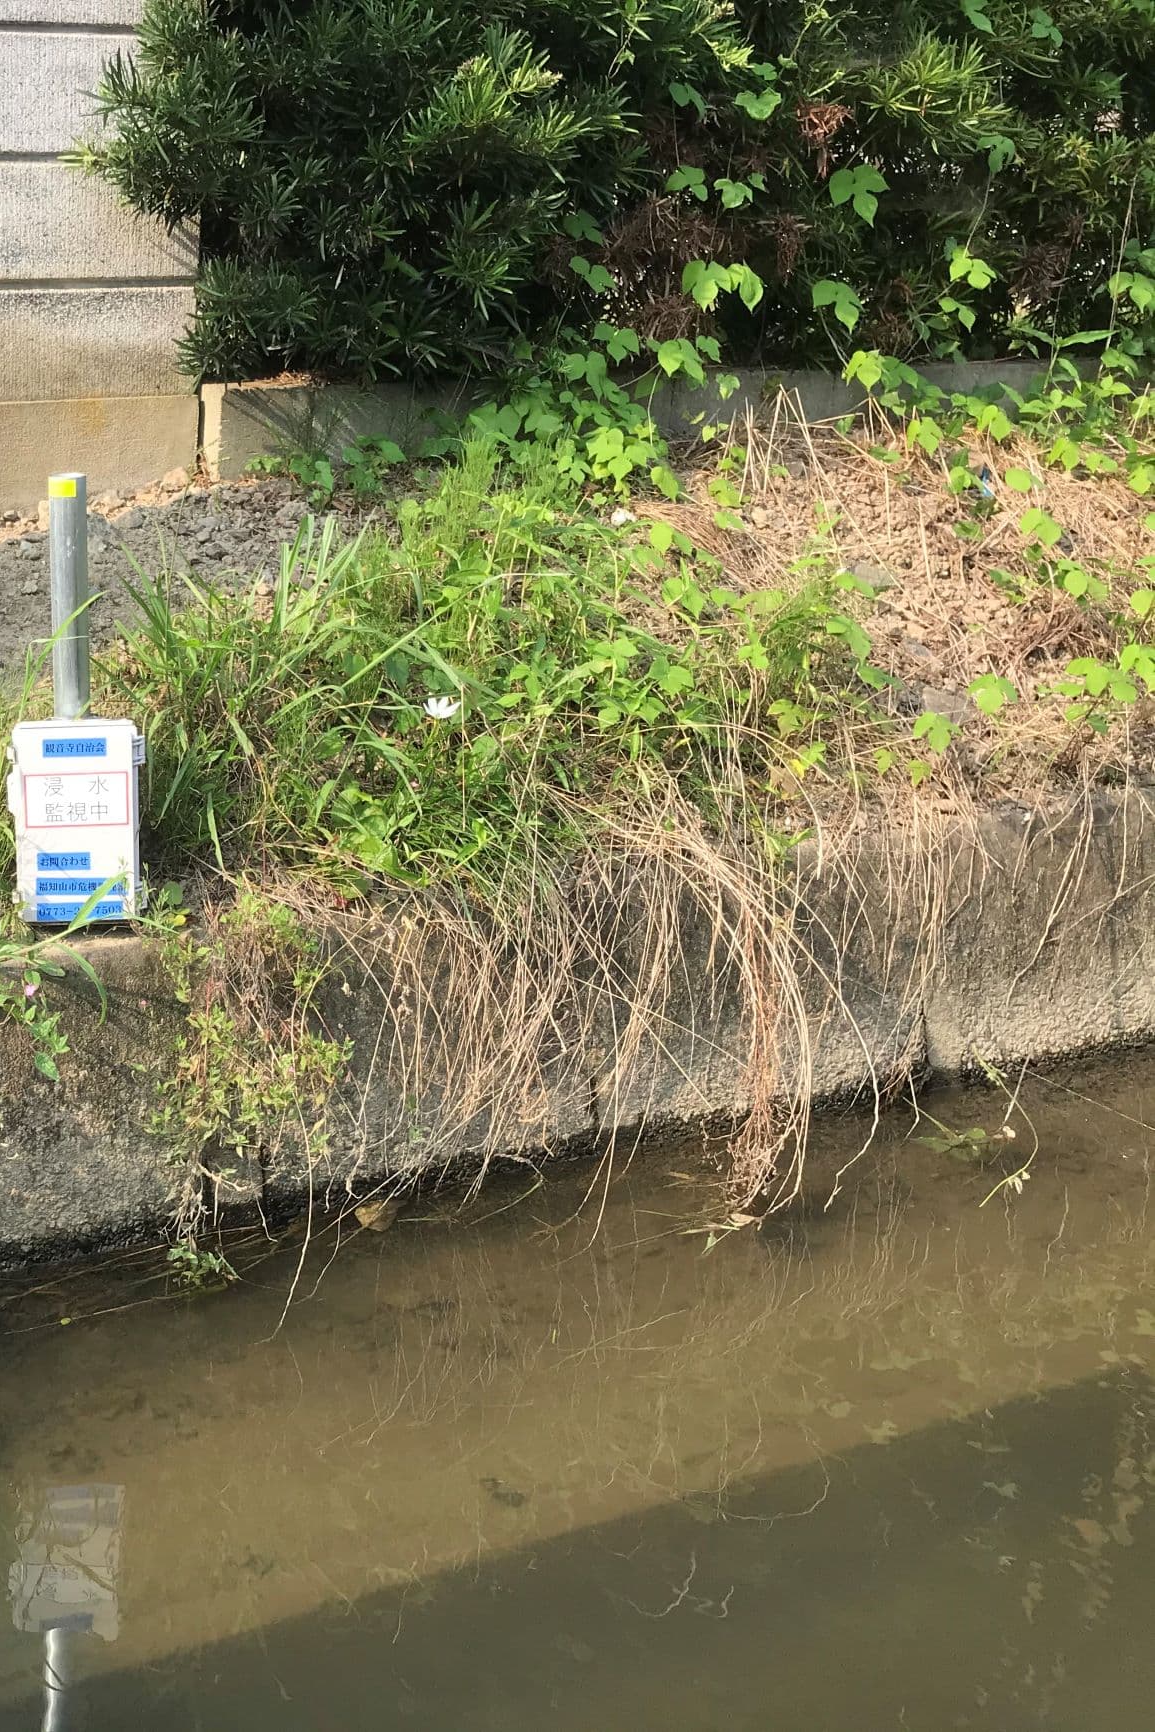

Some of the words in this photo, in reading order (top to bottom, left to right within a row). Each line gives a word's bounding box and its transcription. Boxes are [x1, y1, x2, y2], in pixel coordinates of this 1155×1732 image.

[45, 742, 106, 754] 観音寺自治会
[45, 801, 109, 822] 監視中
[40, 856, 89, 867] お問合わせ
[39, 905, 123, 917] 0773-27503
